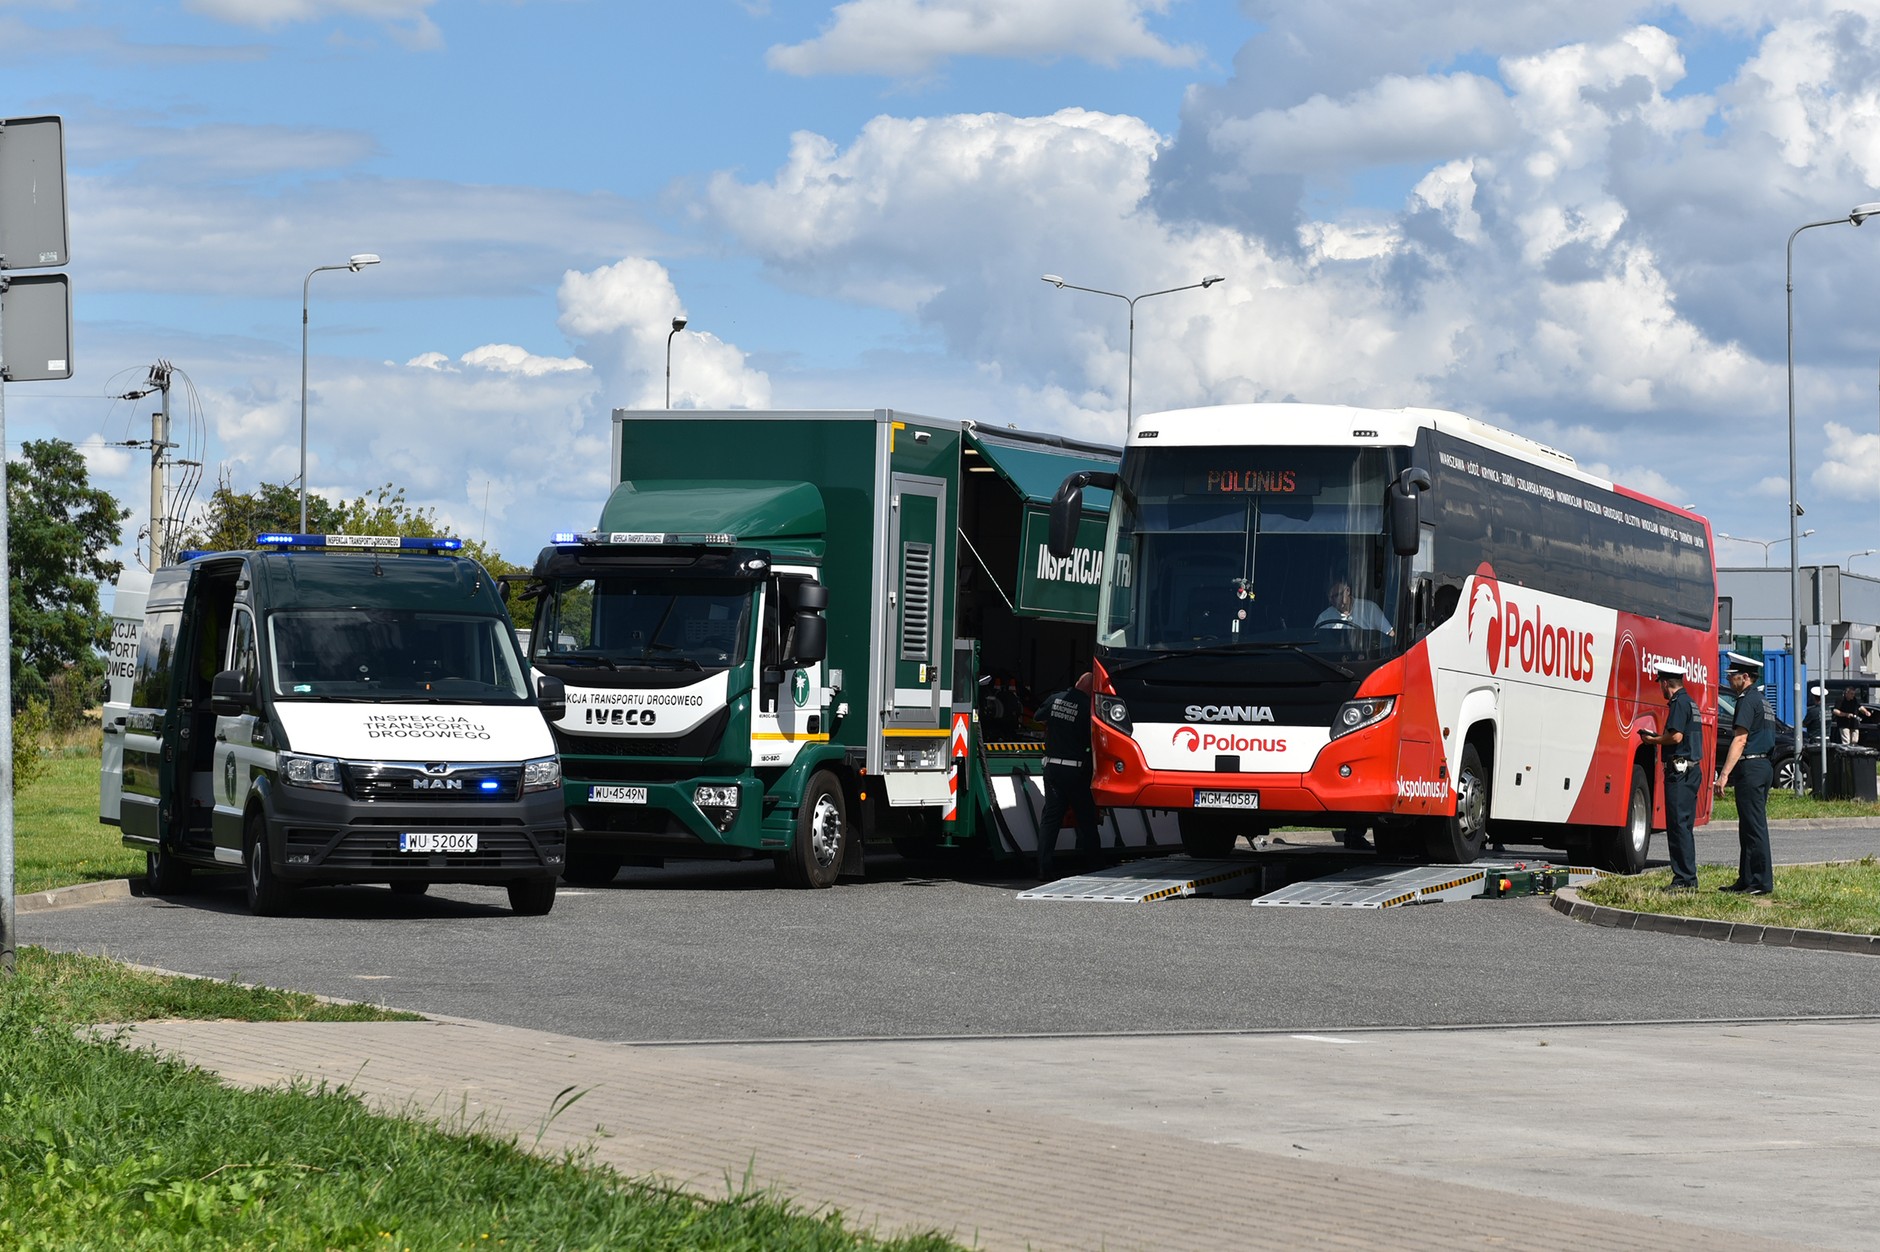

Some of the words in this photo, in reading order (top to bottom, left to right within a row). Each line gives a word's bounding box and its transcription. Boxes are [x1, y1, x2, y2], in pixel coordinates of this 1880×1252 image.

[1207, 470, 1296, 492] POLONUS
[1438, 451, 1466, 472] WARSZAWA
[1467, 460, 1480, 477] ŁÓDŹ
[1516, 477, 1539, 496] SZKLARSKA
[1539, 485, 1555, 502] PORĘBA
[1556, 490, 1582, 509] INOWROCŁAW
[1583, 499, 1602, 516] KOSZALIN
[1602, 505, 1624, 524] GRUDZIĄDZ
[1624, 513, 1641, 529] OLSZTYN
[1641, 518, 1659, 534] WROCŁAW
[1037, 544, 1104, 585] INSPEKCJA
[1504, 601, 1594, 683] Polonus
[565, 693, 587, 704] KCJA
[590, 693, 644, 705] TRANSPORTU
[646, 694, 703, 706] DROGOWEGO
[368, 715, 469, 723] INSPEKCJA
[585, 708, 656, 725] IVECO
[1184, 704, 1275, 722] SCANIA
[363, 722, 485, 732] TRANSPORTU
[368, 730, 491, 740] DROGOWEGO
[1203, 733, 1287, 752] Polonus
[413, 779, 462, 789] MAN
[596, 787, 609, 799] WU
[612, 788, 645, 800] 4549N
[1200, 792, 1222, 804] WGM
[1225, 793, 1257, 806] 40587
[409, 834, 427, 848] WU
[432, 834, 474, 848] 5206K
